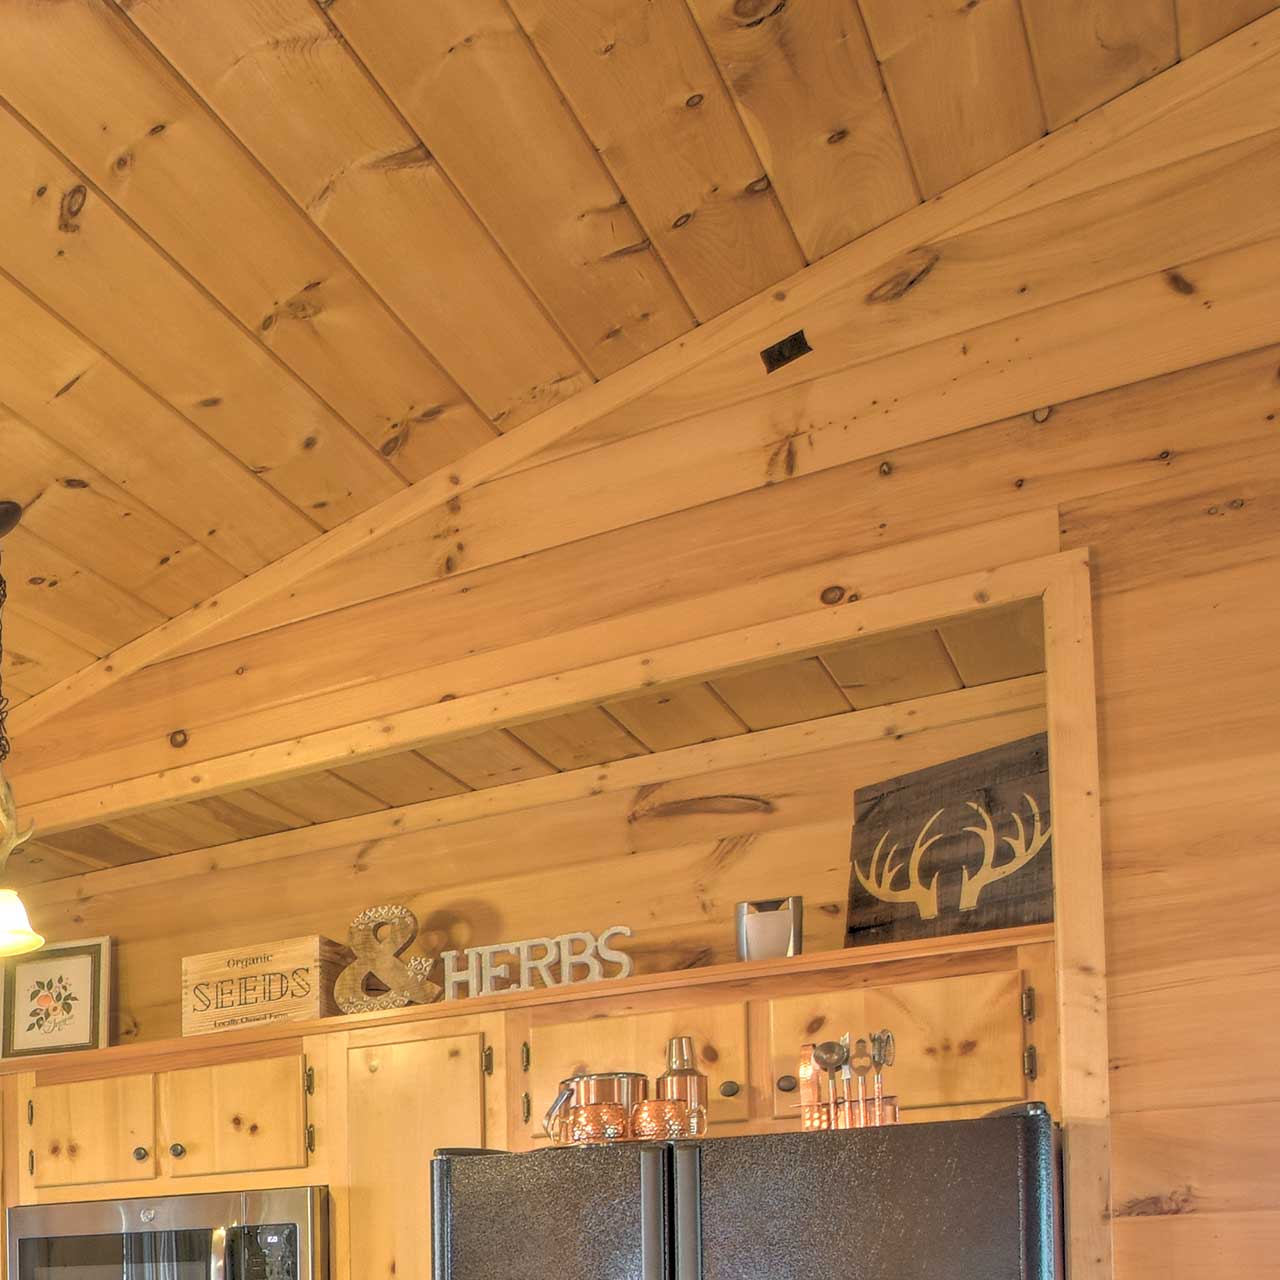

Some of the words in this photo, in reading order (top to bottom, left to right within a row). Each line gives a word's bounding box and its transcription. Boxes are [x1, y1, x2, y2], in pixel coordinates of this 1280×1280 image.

[227, 953, 273, 969] Organic
[334, 904, 444, 1015] &
[440, 926, 634, 1000] HERBS
[193, 967, 311, 1013] SEEDS
